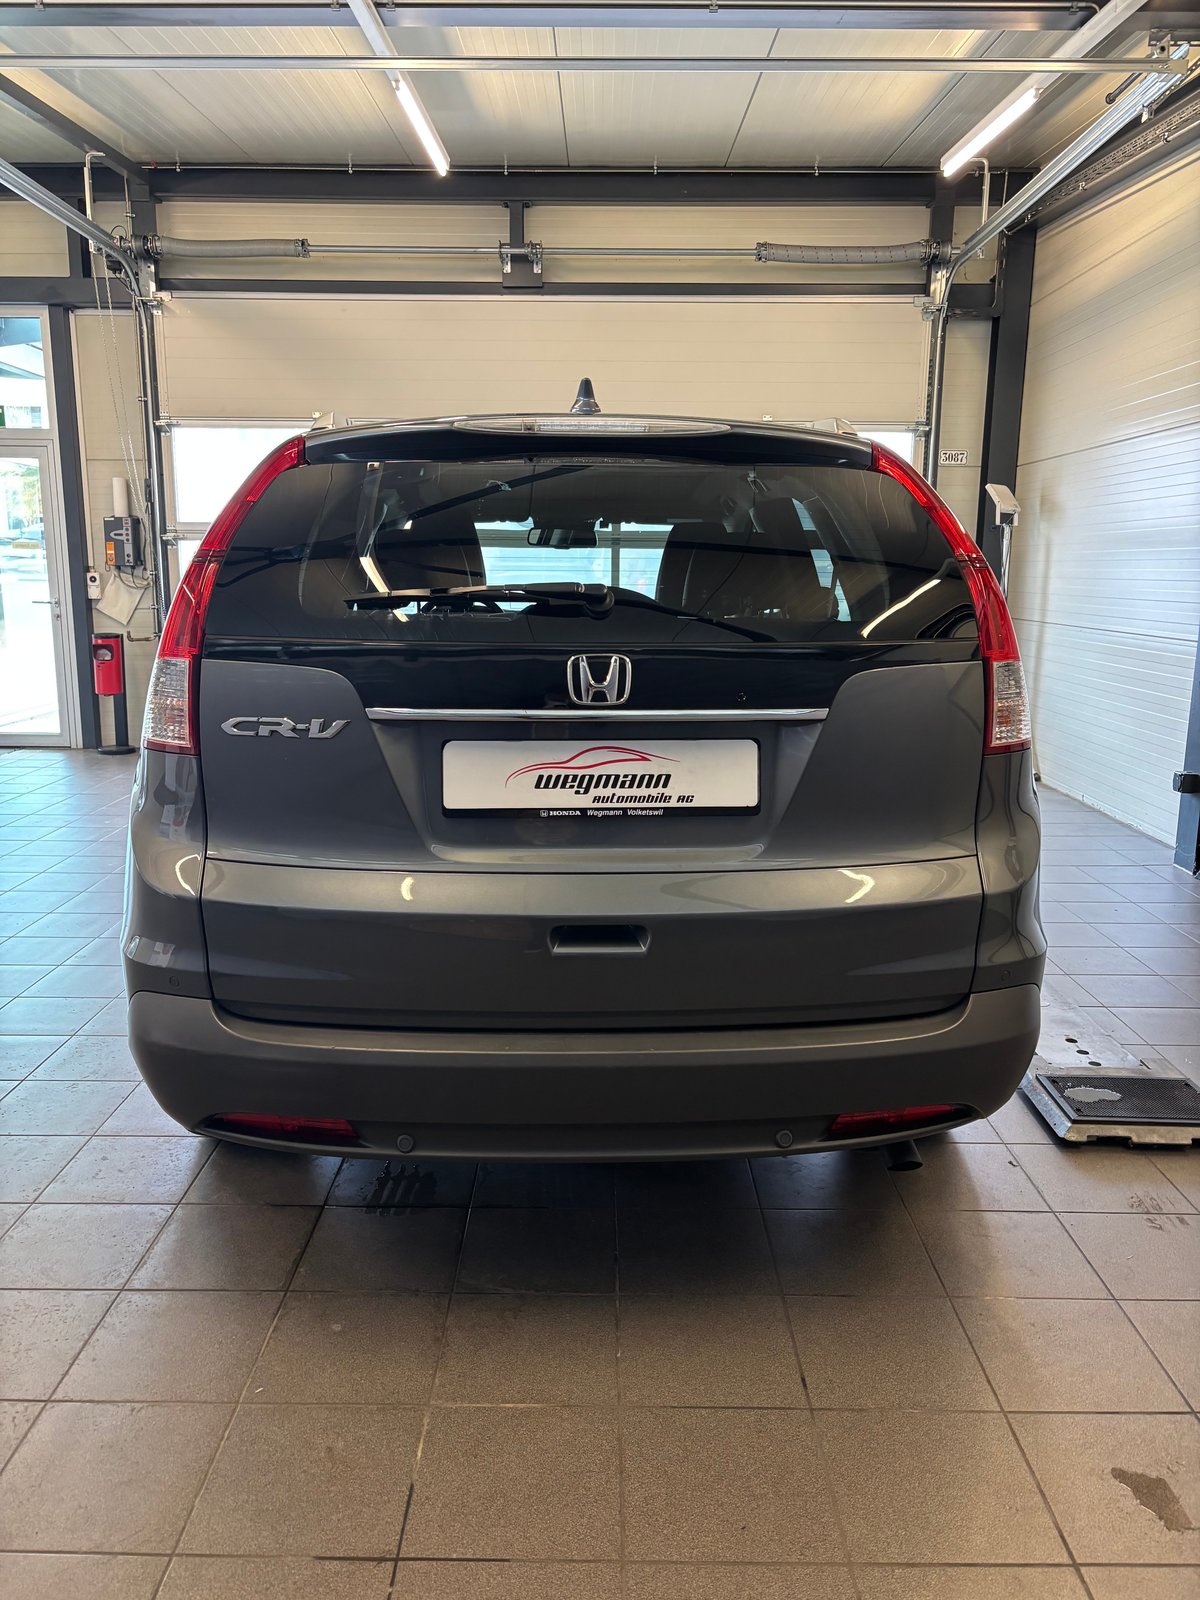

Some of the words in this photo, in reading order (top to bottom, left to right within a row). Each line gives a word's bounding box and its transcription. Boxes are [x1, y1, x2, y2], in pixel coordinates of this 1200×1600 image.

[942, 452, 965, 463] 3087
[220, 716, 351, 738] CR-V
[534, 773, 672, 795] wegmann
[676, 794, 695, 804] AG
[587, 809, 623, 817] Wegmann
[627, 808, 664, 816] Volketswil
